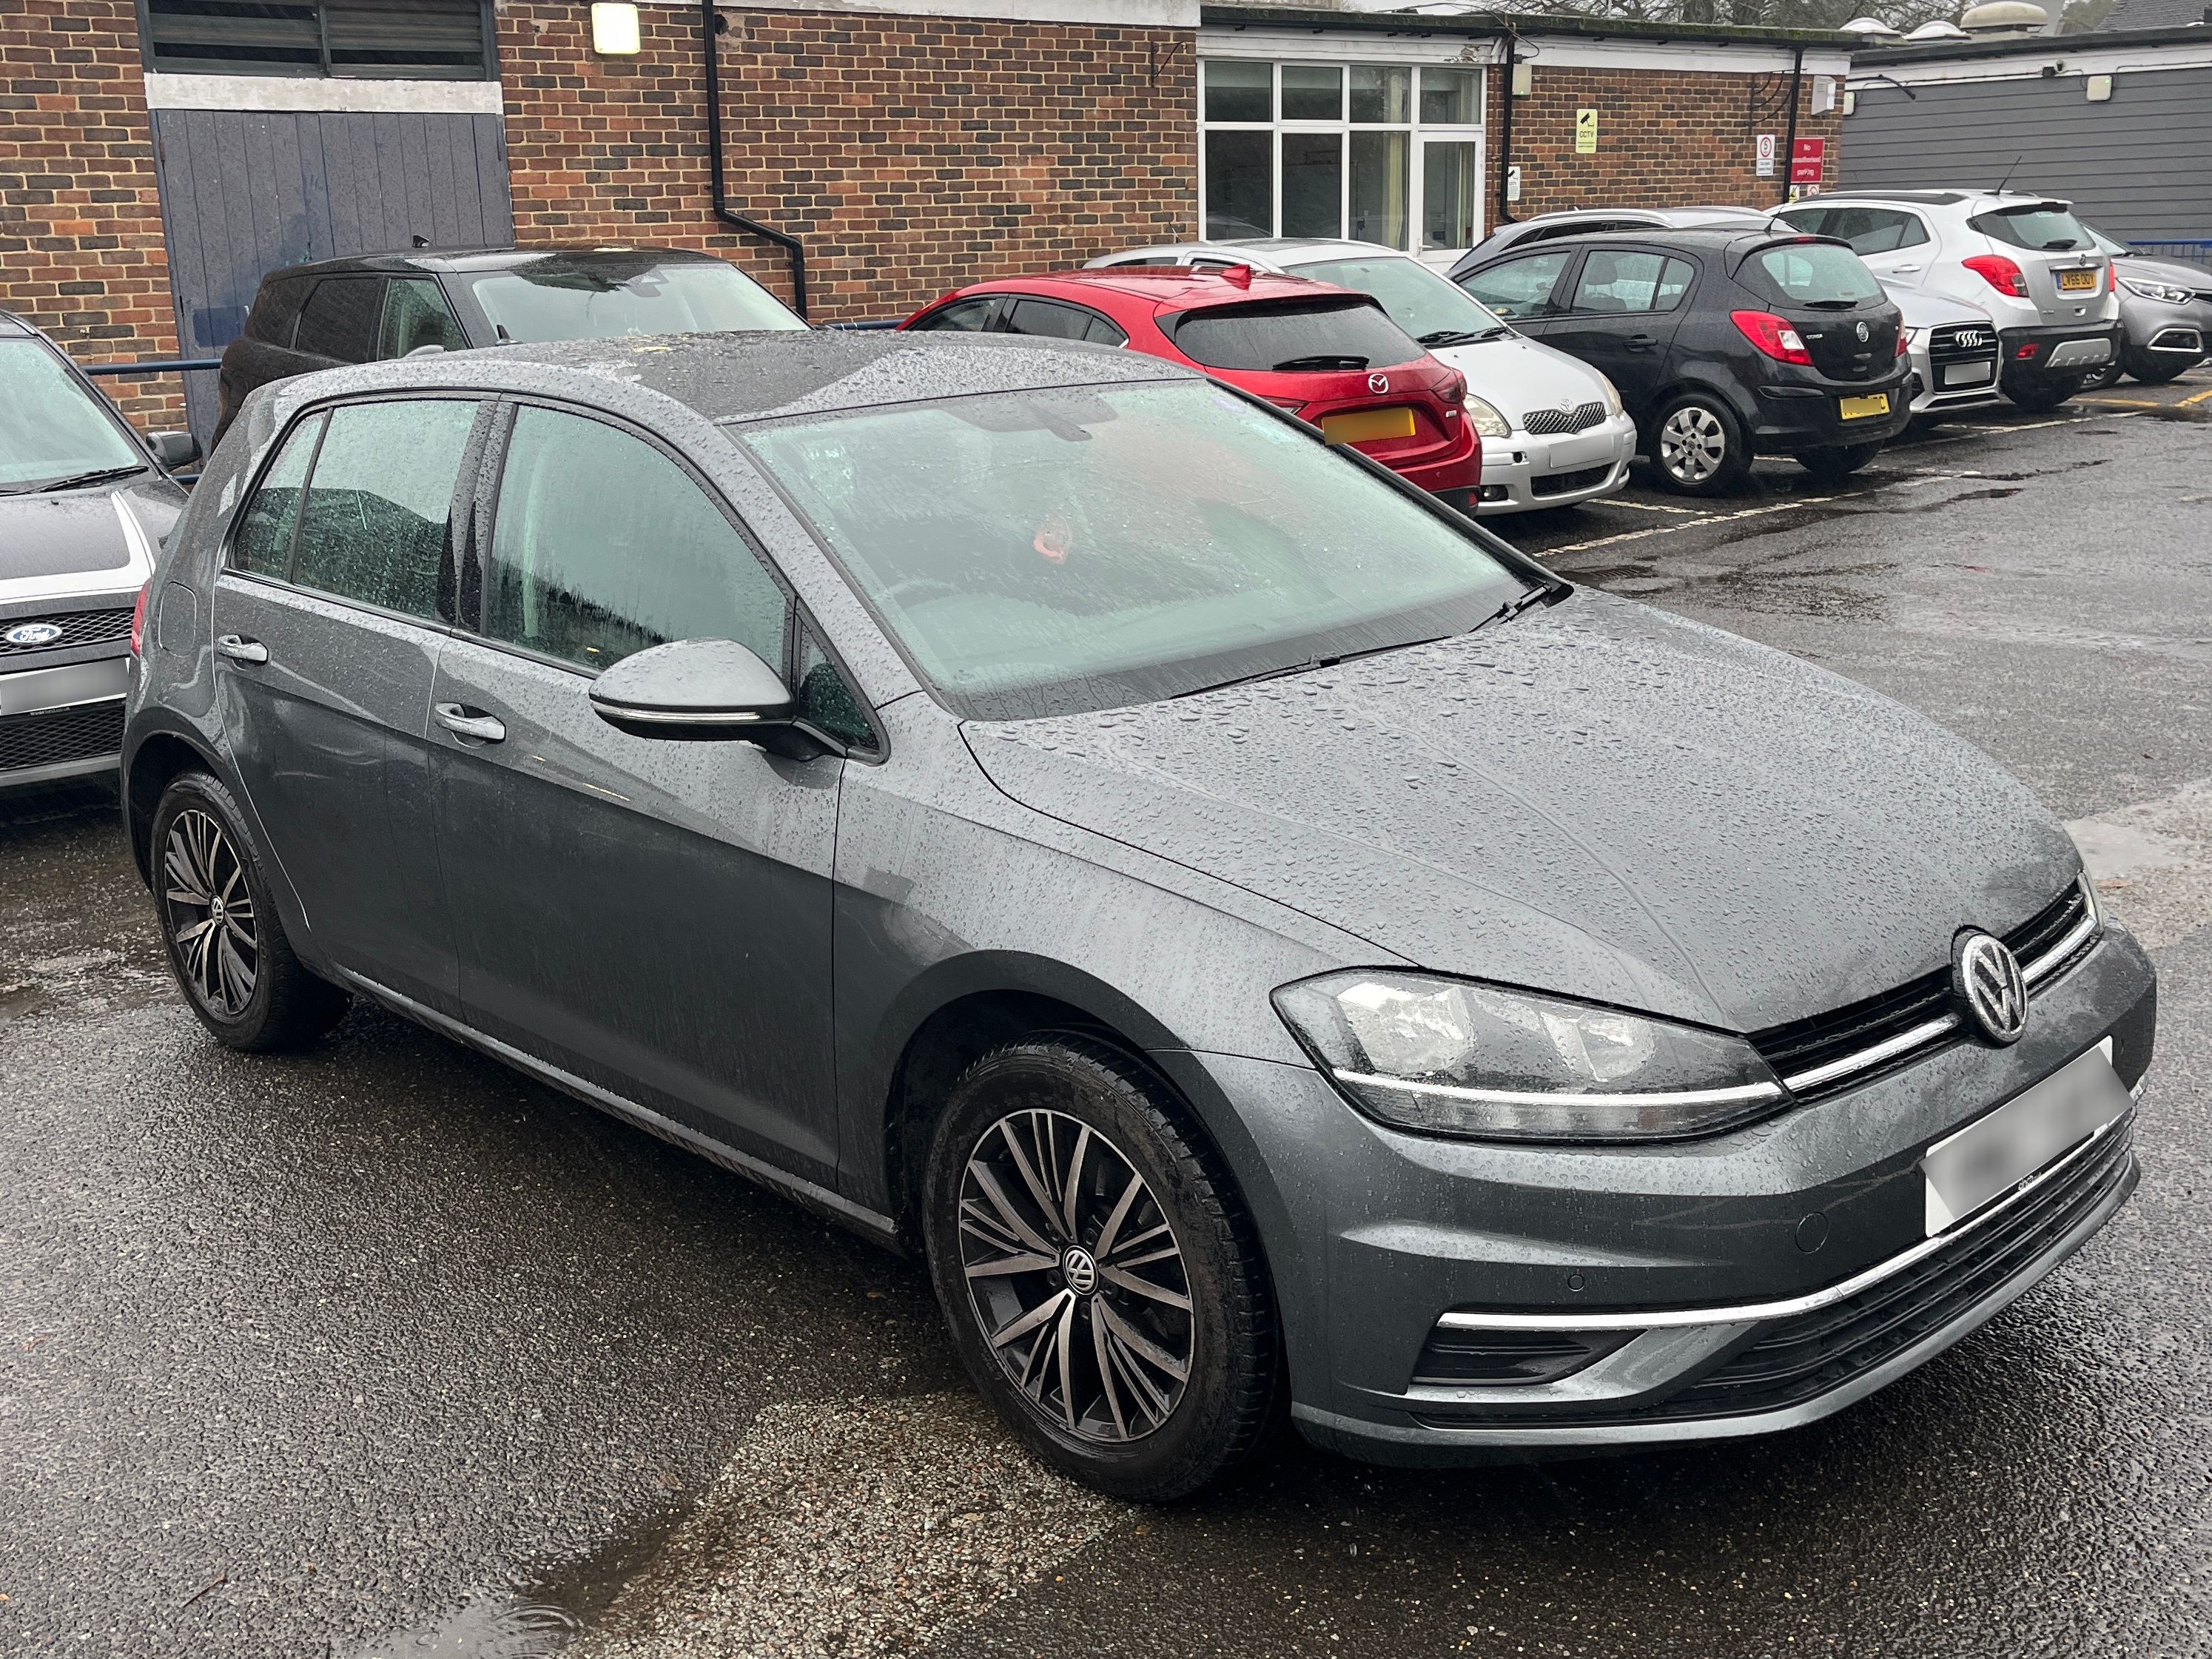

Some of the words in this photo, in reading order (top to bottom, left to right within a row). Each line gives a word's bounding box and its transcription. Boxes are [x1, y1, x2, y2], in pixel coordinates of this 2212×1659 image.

[1579, 130, 1595, 138] CCTV
[1764, 140, 1769, 150] 5
[1803, 143, 1812, 152] No
